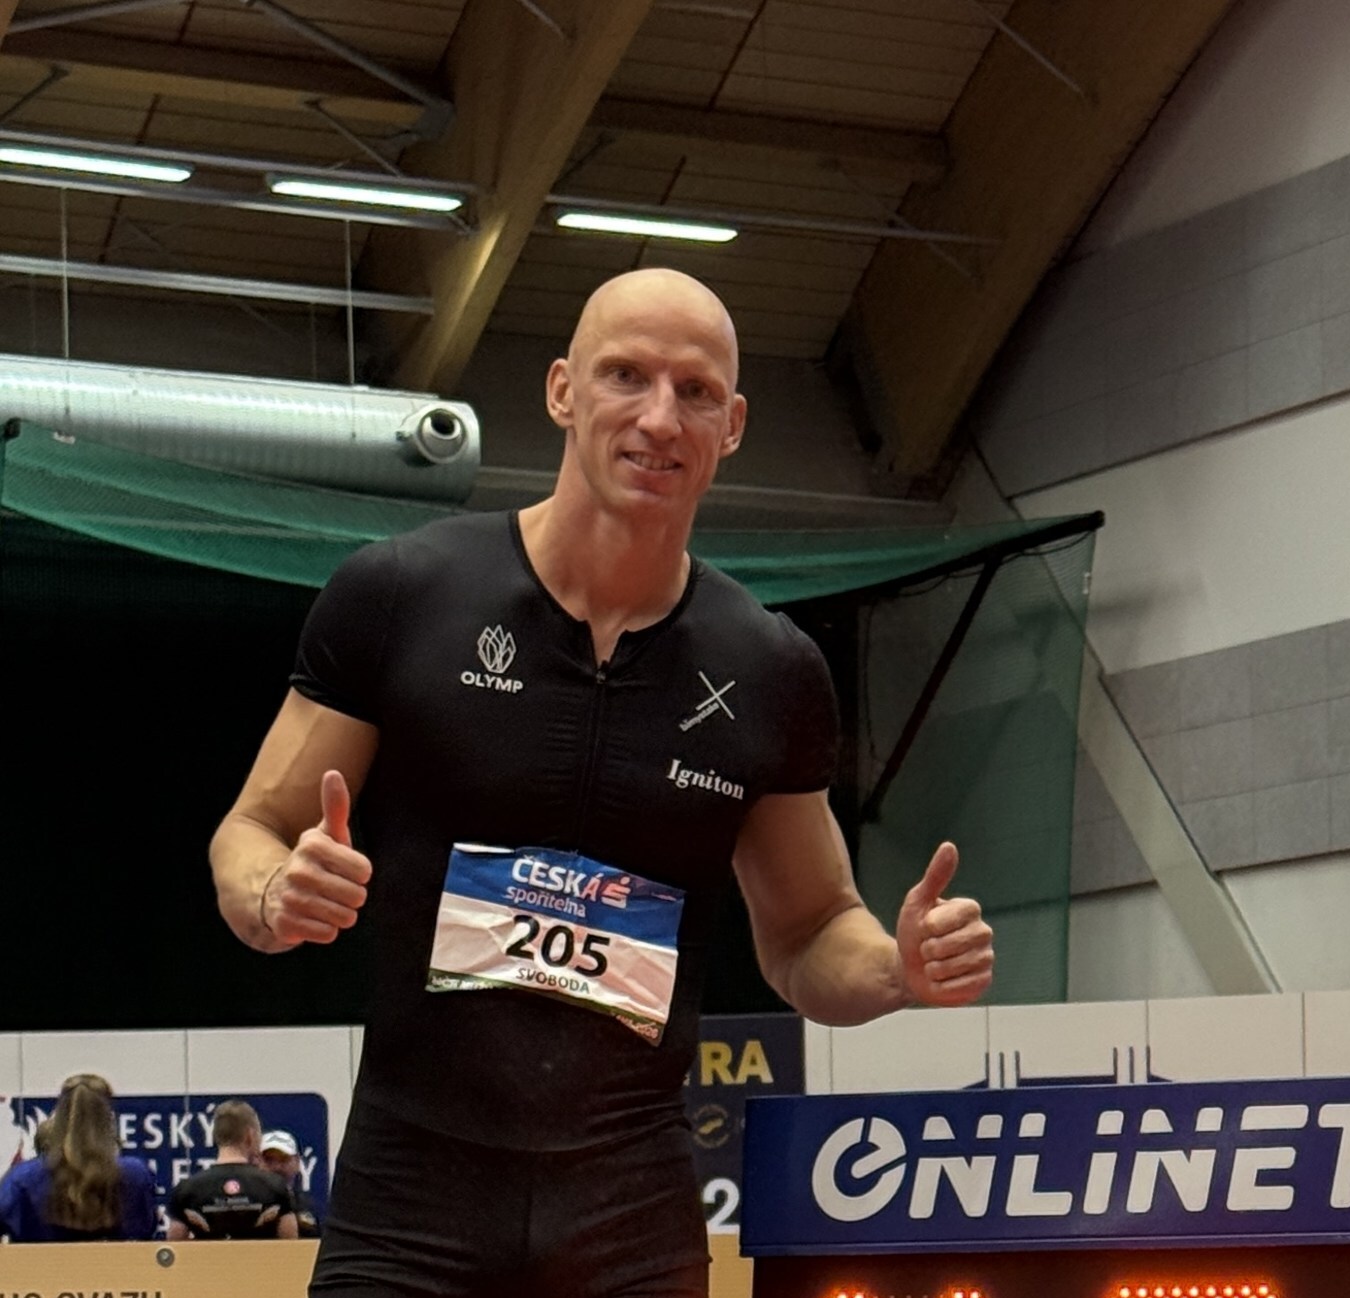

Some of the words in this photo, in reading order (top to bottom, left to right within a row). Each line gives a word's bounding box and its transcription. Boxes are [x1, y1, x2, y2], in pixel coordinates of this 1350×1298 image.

[460, 671, 523, 695] OLYMP
[667, 759, 744, 800] Igniton
[512, 855, 603, 901] ČESKÁ
[503, 886, 586, 918] spořitelna
[505, 914, 610, 977] 205
[516, 967, 590, 994] SVOBODA
[684, 1040, 774, 1086] RA
[111, 1103, 215, 1149] ESKÝ
